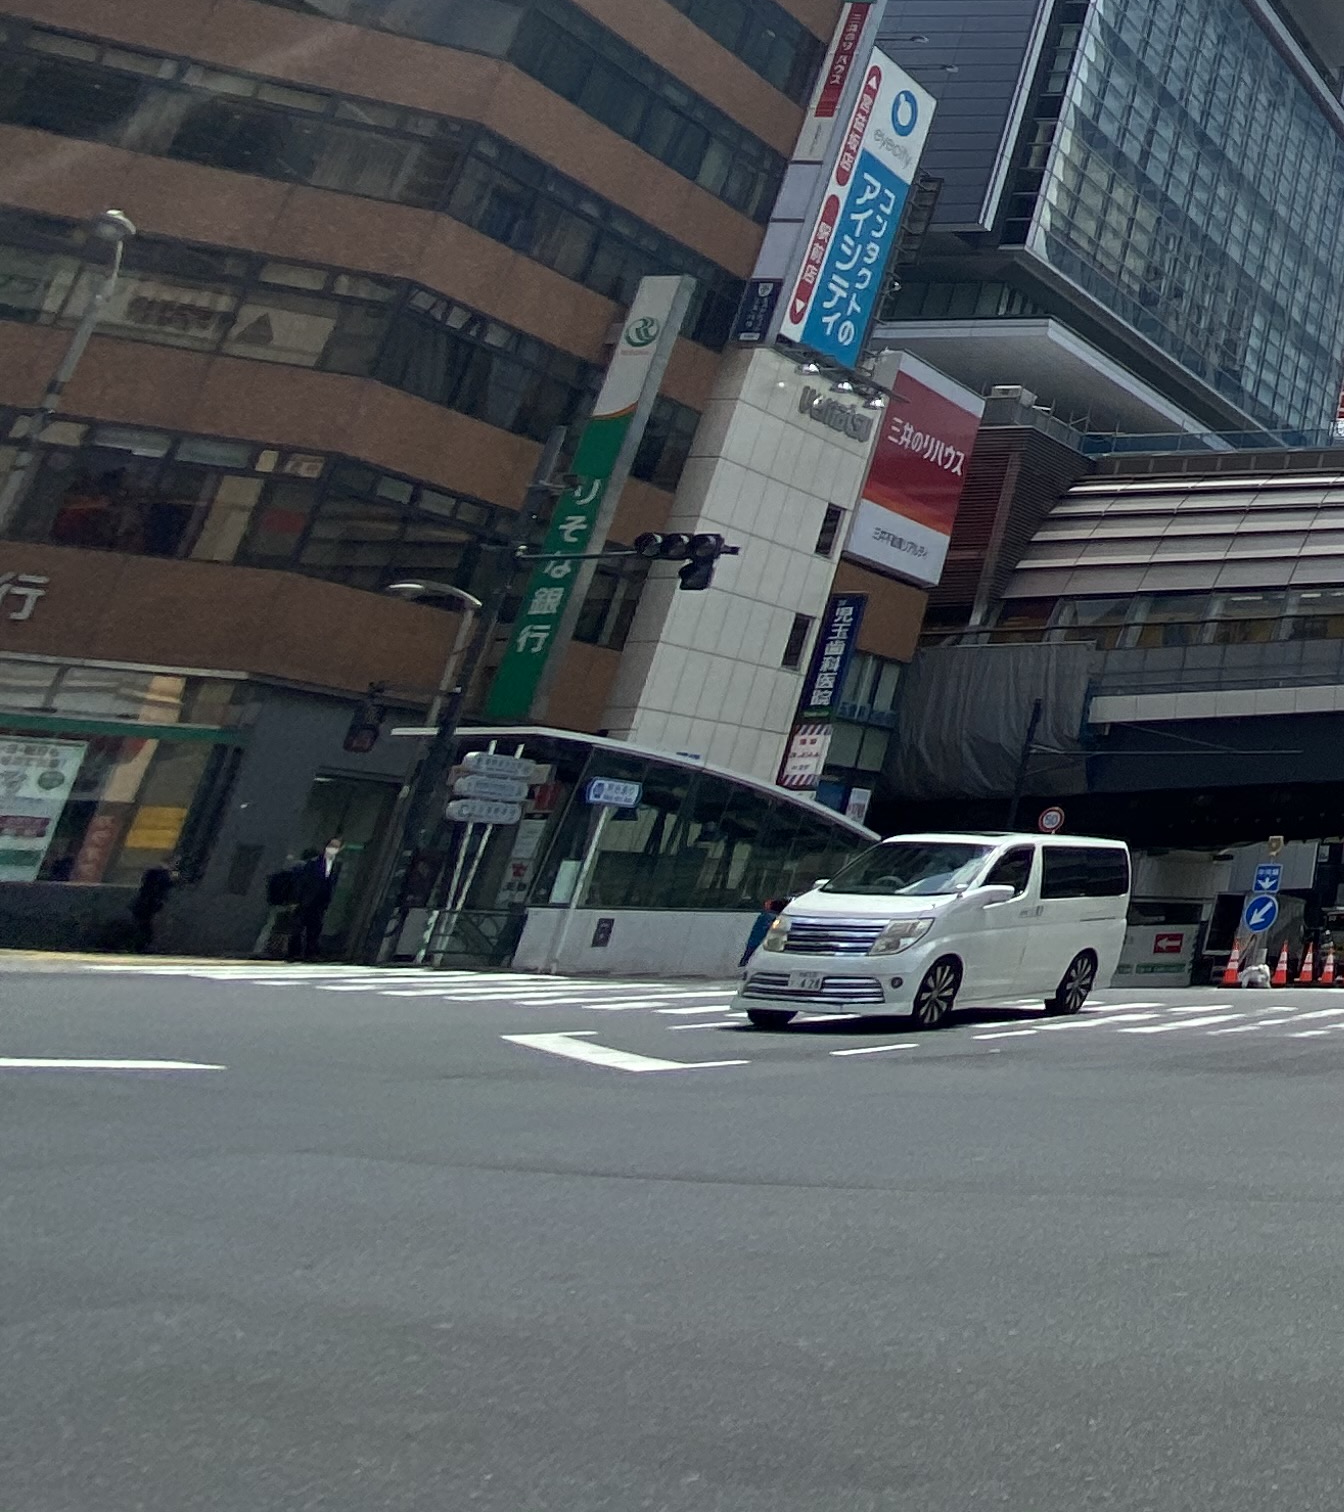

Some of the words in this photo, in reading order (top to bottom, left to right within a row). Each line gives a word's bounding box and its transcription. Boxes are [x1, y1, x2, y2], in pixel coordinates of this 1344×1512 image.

[820, 172, 882, 337] アイシティ
[836, 187, 897, 347] コンタクトの
[887, 416, 967, 477] 三井のリハウス
[516, 478, 602, 654] りそな銀行
[809, 605, 854, 707] 児玉歯科医院
